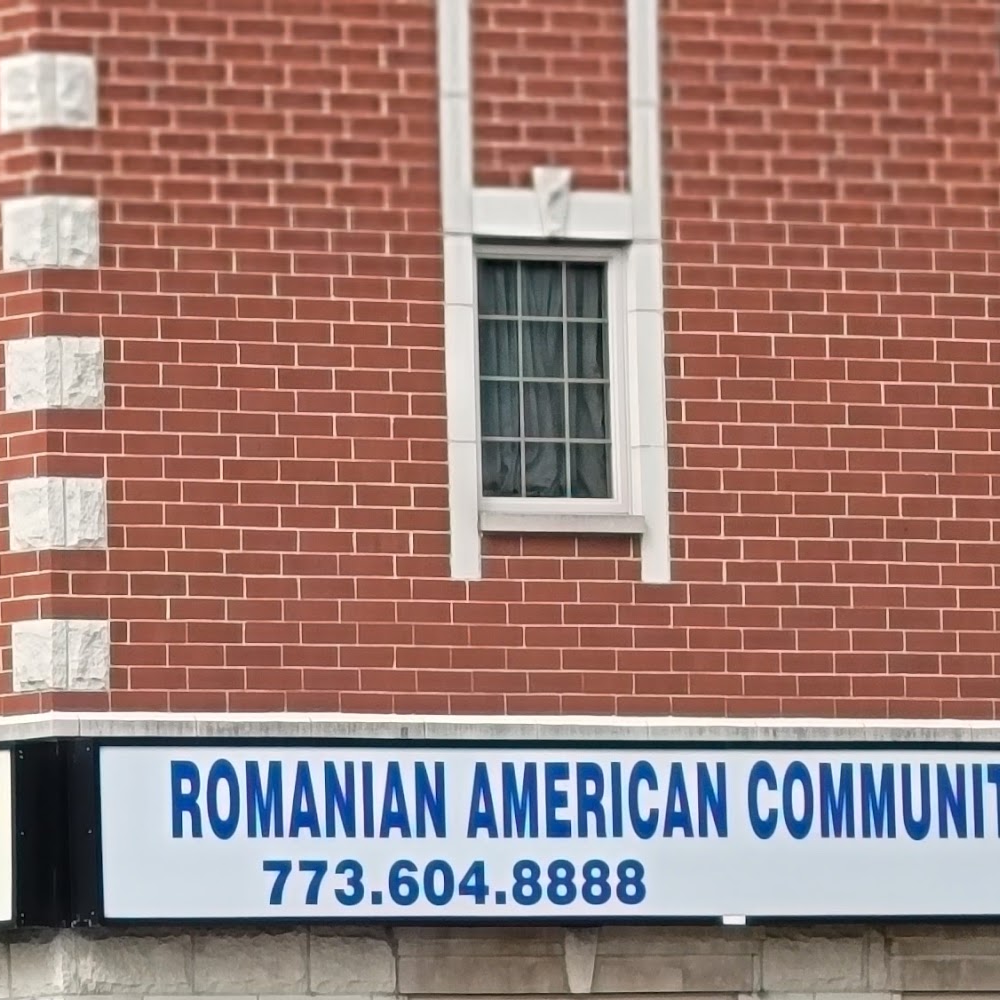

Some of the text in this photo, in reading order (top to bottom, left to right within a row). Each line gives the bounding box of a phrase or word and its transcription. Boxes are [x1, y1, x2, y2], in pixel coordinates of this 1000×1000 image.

[171, 759, 446, 840] ROMANIAN
[467, 760, 728, 840] AMERICAN
[262, 859, 647, 906] 773.604.8888
